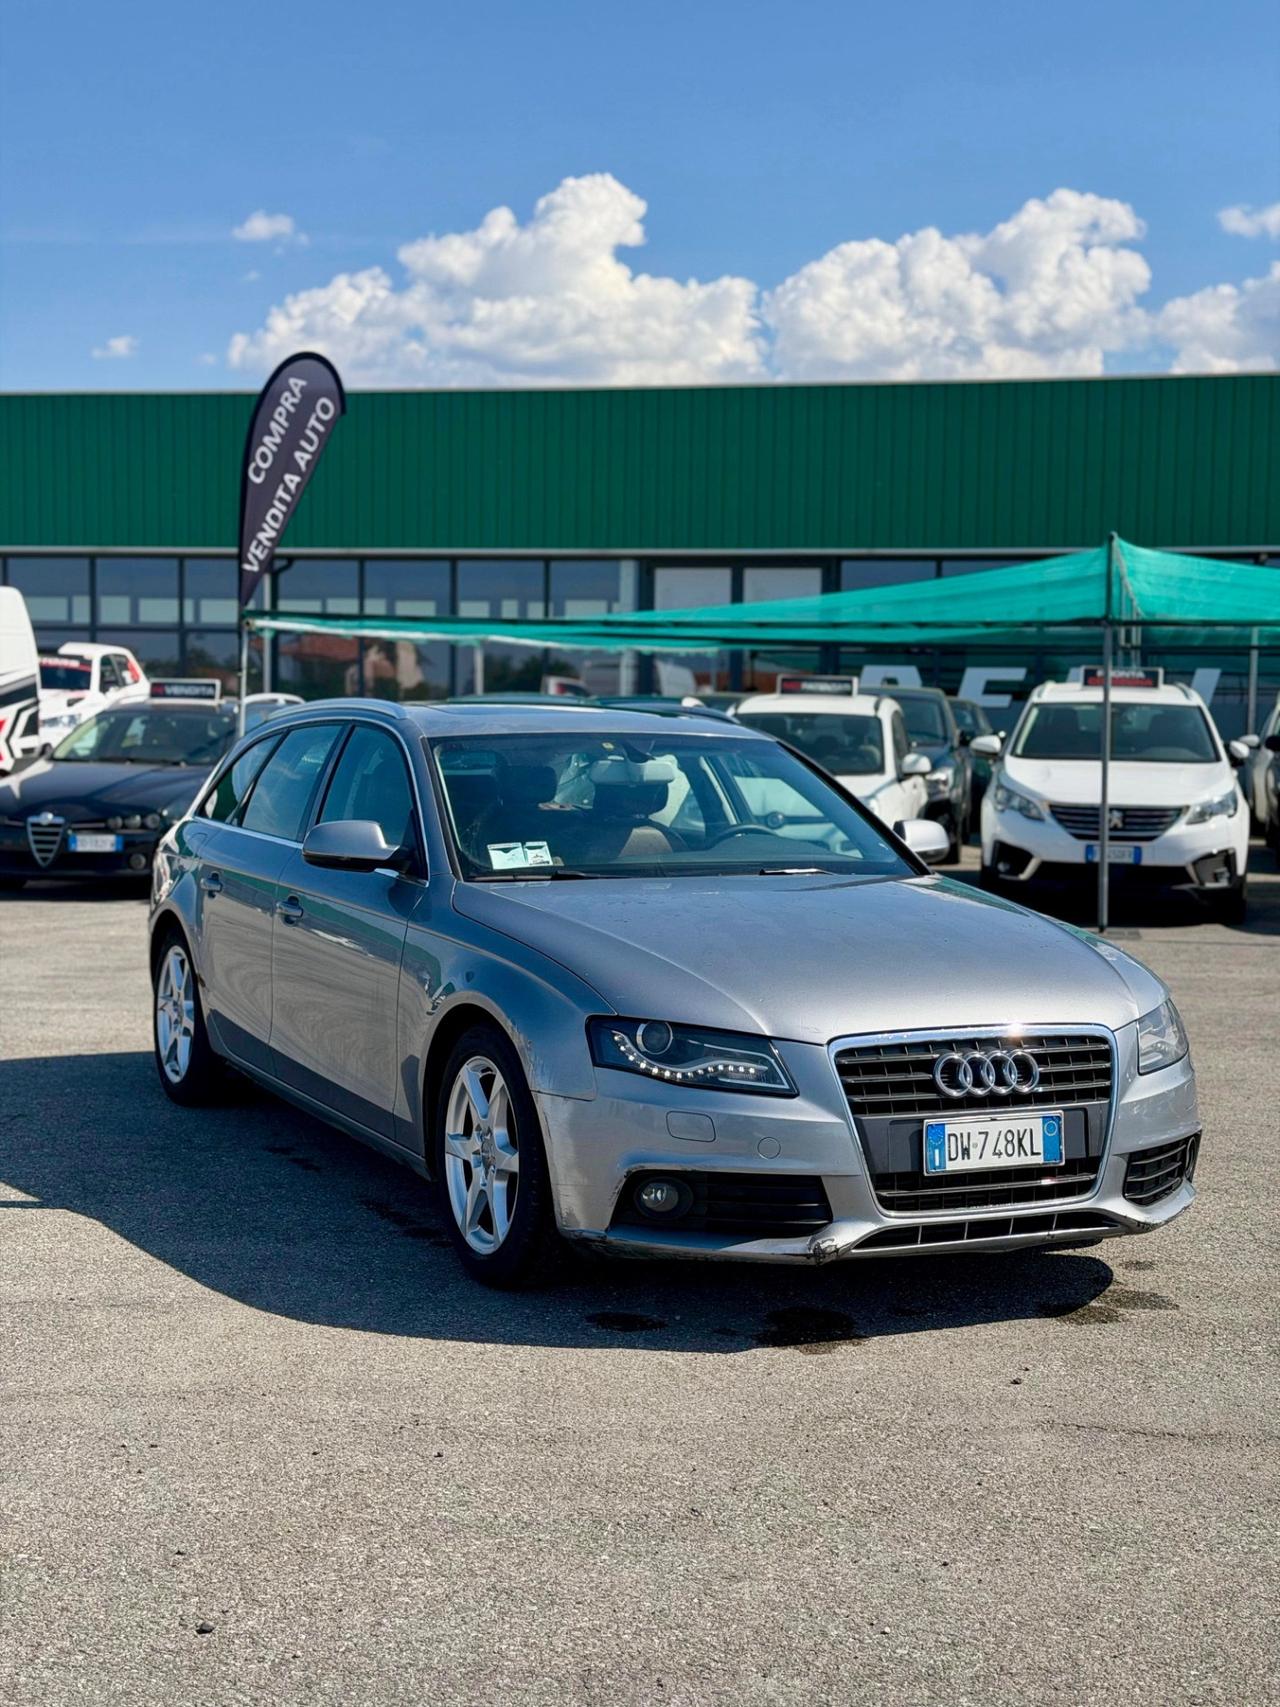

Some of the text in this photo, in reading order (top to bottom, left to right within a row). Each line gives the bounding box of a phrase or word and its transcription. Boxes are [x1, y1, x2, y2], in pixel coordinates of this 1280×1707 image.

[242, 397, 335, 573] VENDITA AUTO
[248, 376, 308, 485] COMPRA
